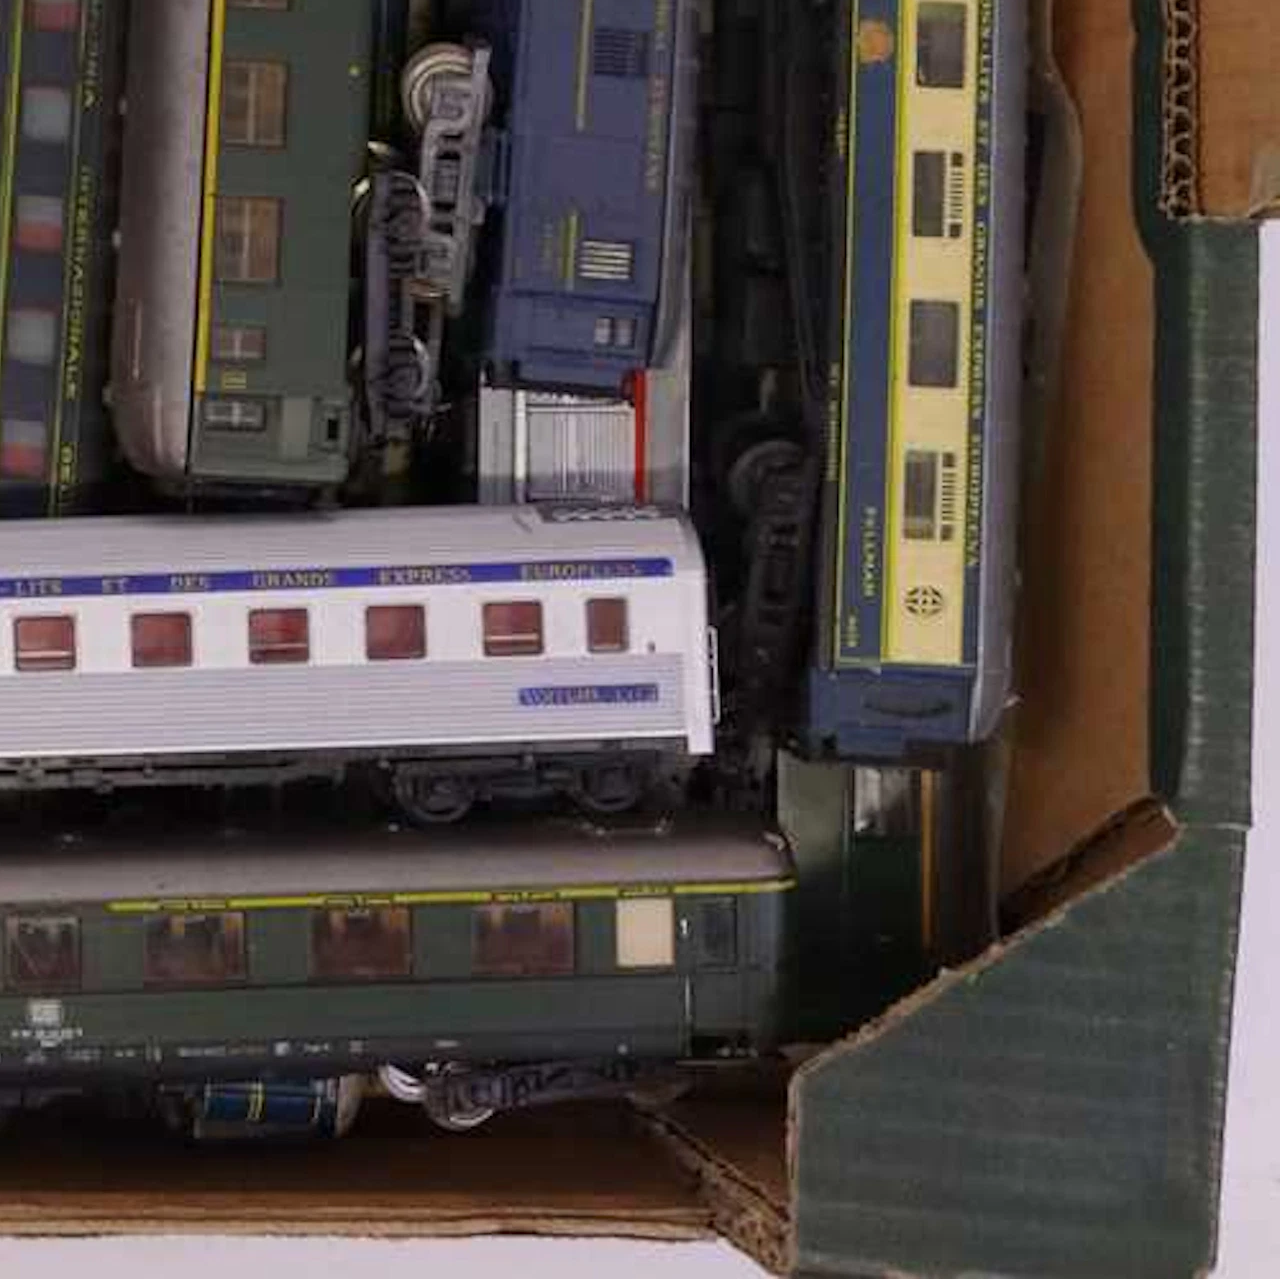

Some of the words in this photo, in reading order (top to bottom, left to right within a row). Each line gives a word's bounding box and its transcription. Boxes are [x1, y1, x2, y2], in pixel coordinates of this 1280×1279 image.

[102, 577, 127, 593] ET
[170, 575, 211, 592] DES
[252, 571, 336, 589] GRANDS
[378, 568, 471, 586] EXPRESS
[679, 918, 687, 935] 1
